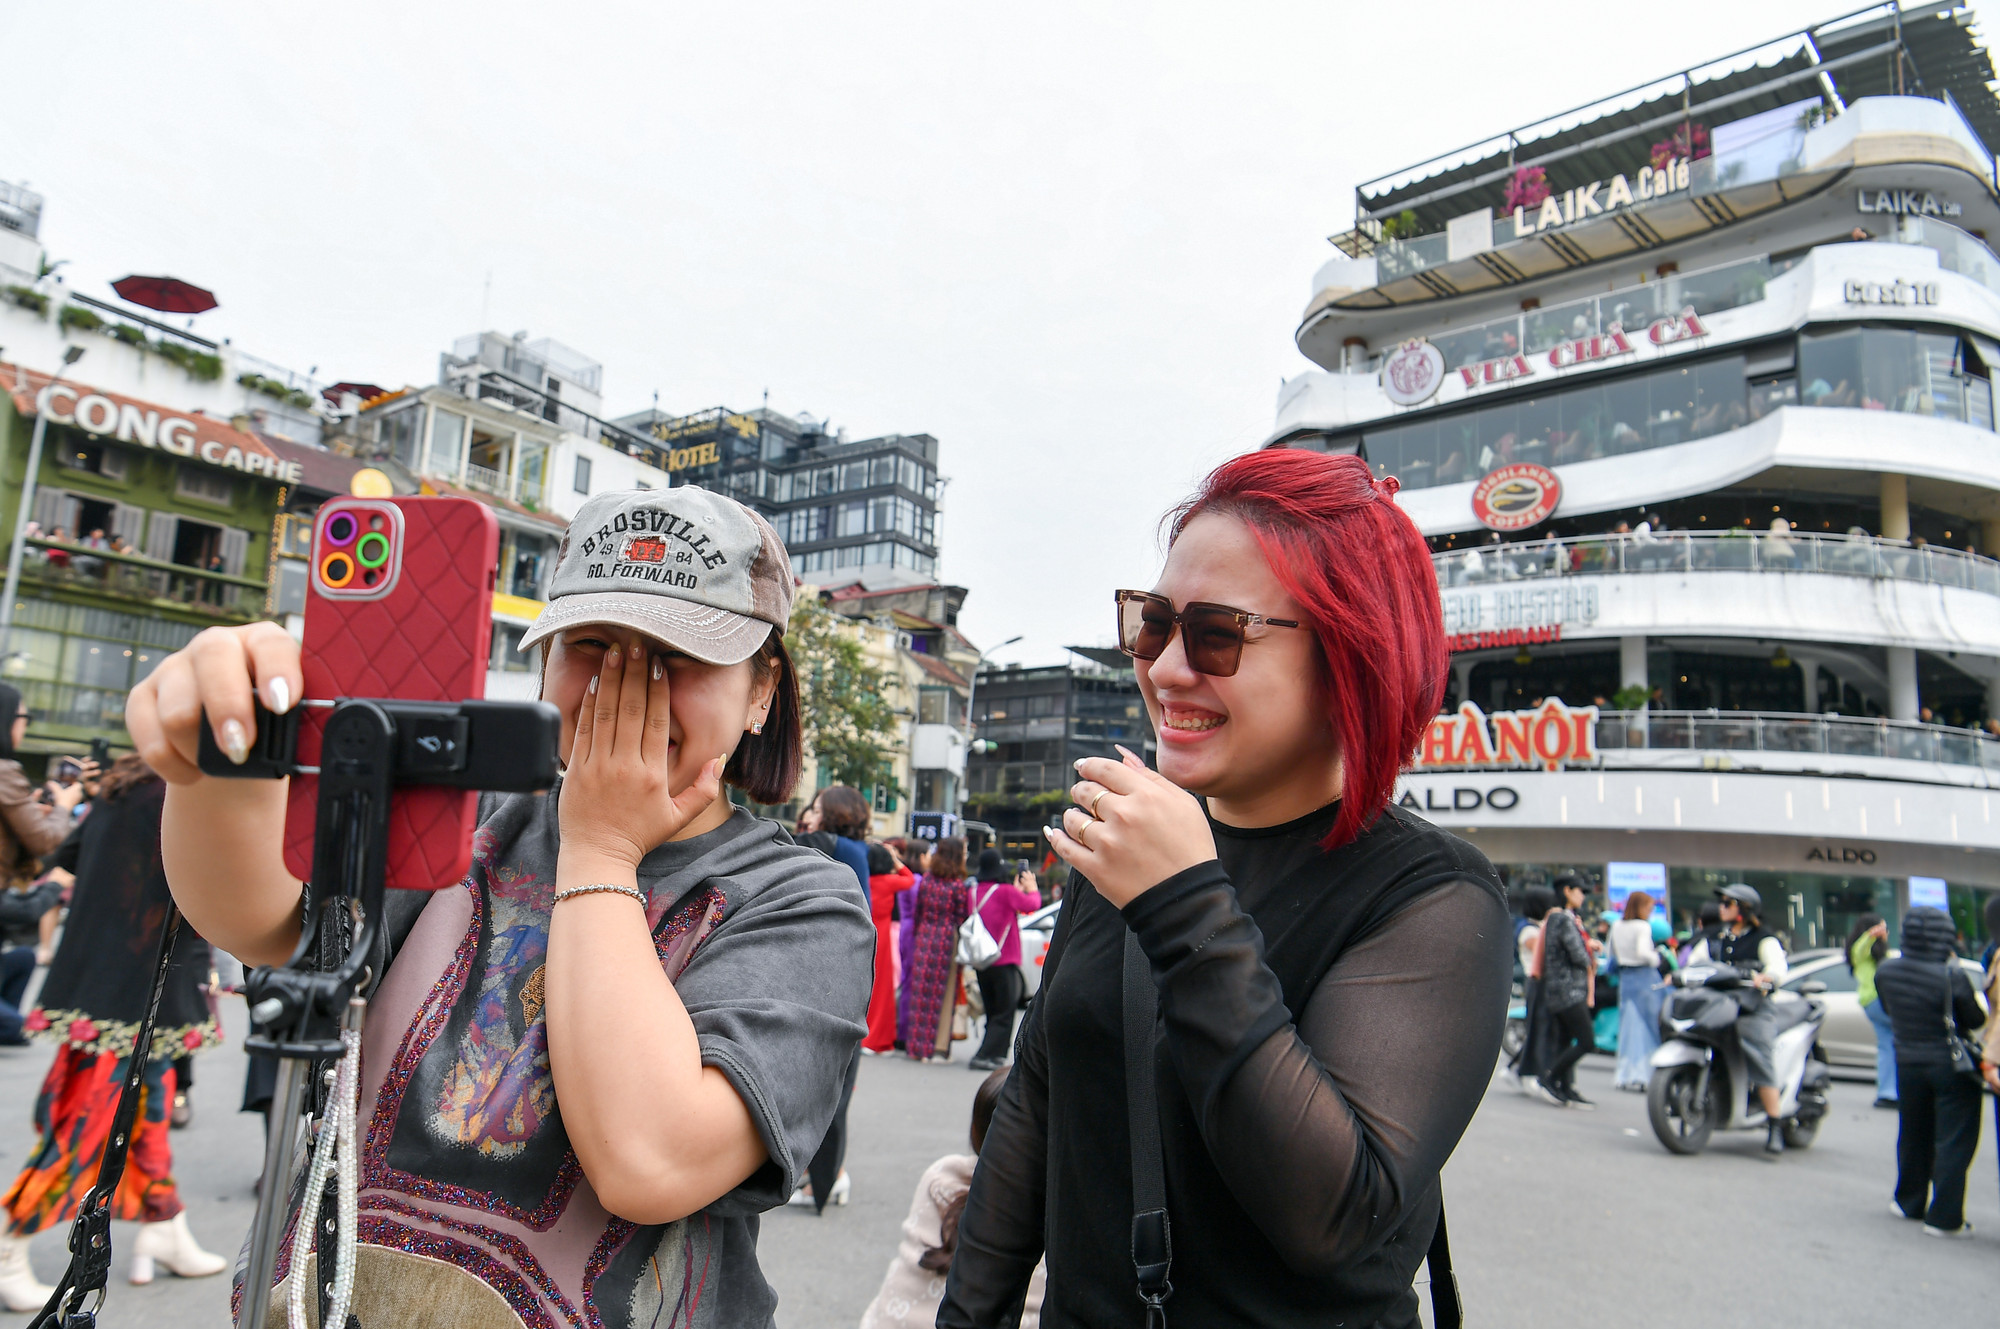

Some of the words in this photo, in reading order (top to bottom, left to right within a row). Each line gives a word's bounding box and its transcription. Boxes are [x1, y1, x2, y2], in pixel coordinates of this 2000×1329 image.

[1514, 173, 1635, 237] LAIKA
[1638, 156, 1690, 200] Café
[1858, 189, 1940, 214] LAIKA
[1457, 351, 1534, 388] VUA
[661, 442, 720, 472] HOTEL
[1476, 467, 1555, 500] HIGHLANDS
[1485, 506, 1547, 527] COFFEE
[581, 509, 727, 570] BROSVILLE
[675, 551, 693, 565] 84
[611, 564, 698, 589] FORWARD
[1399, 787, 1520, 811] ALDO
[1807, 846, 1878, 865] ALDO
